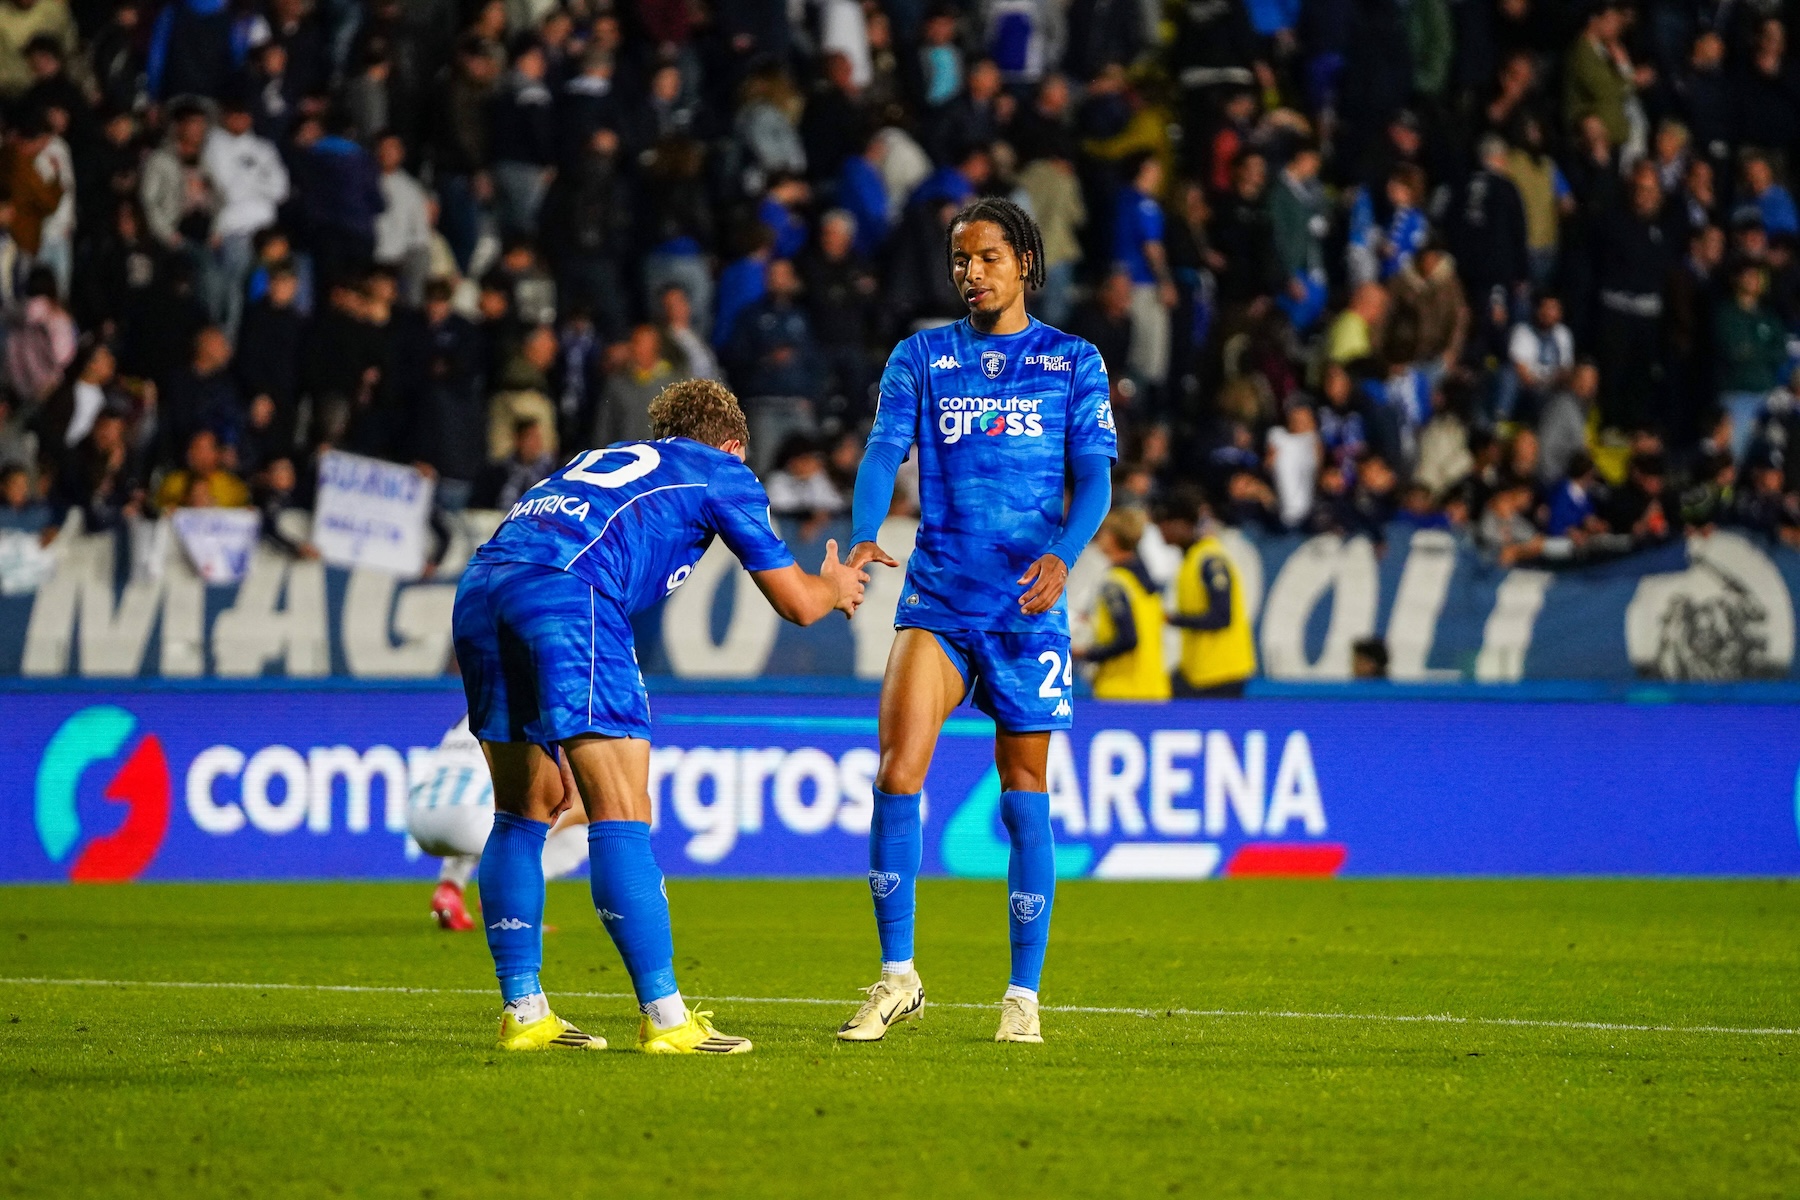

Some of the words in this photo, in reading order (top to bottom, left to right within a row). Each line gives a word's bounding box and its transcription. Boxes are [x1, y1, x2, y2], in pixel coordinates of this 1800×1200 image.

[939, 396, 1043, 412] computer
[939, 411, 1043, 444] gross
[1046, 729, 1327, 835] ARENA
